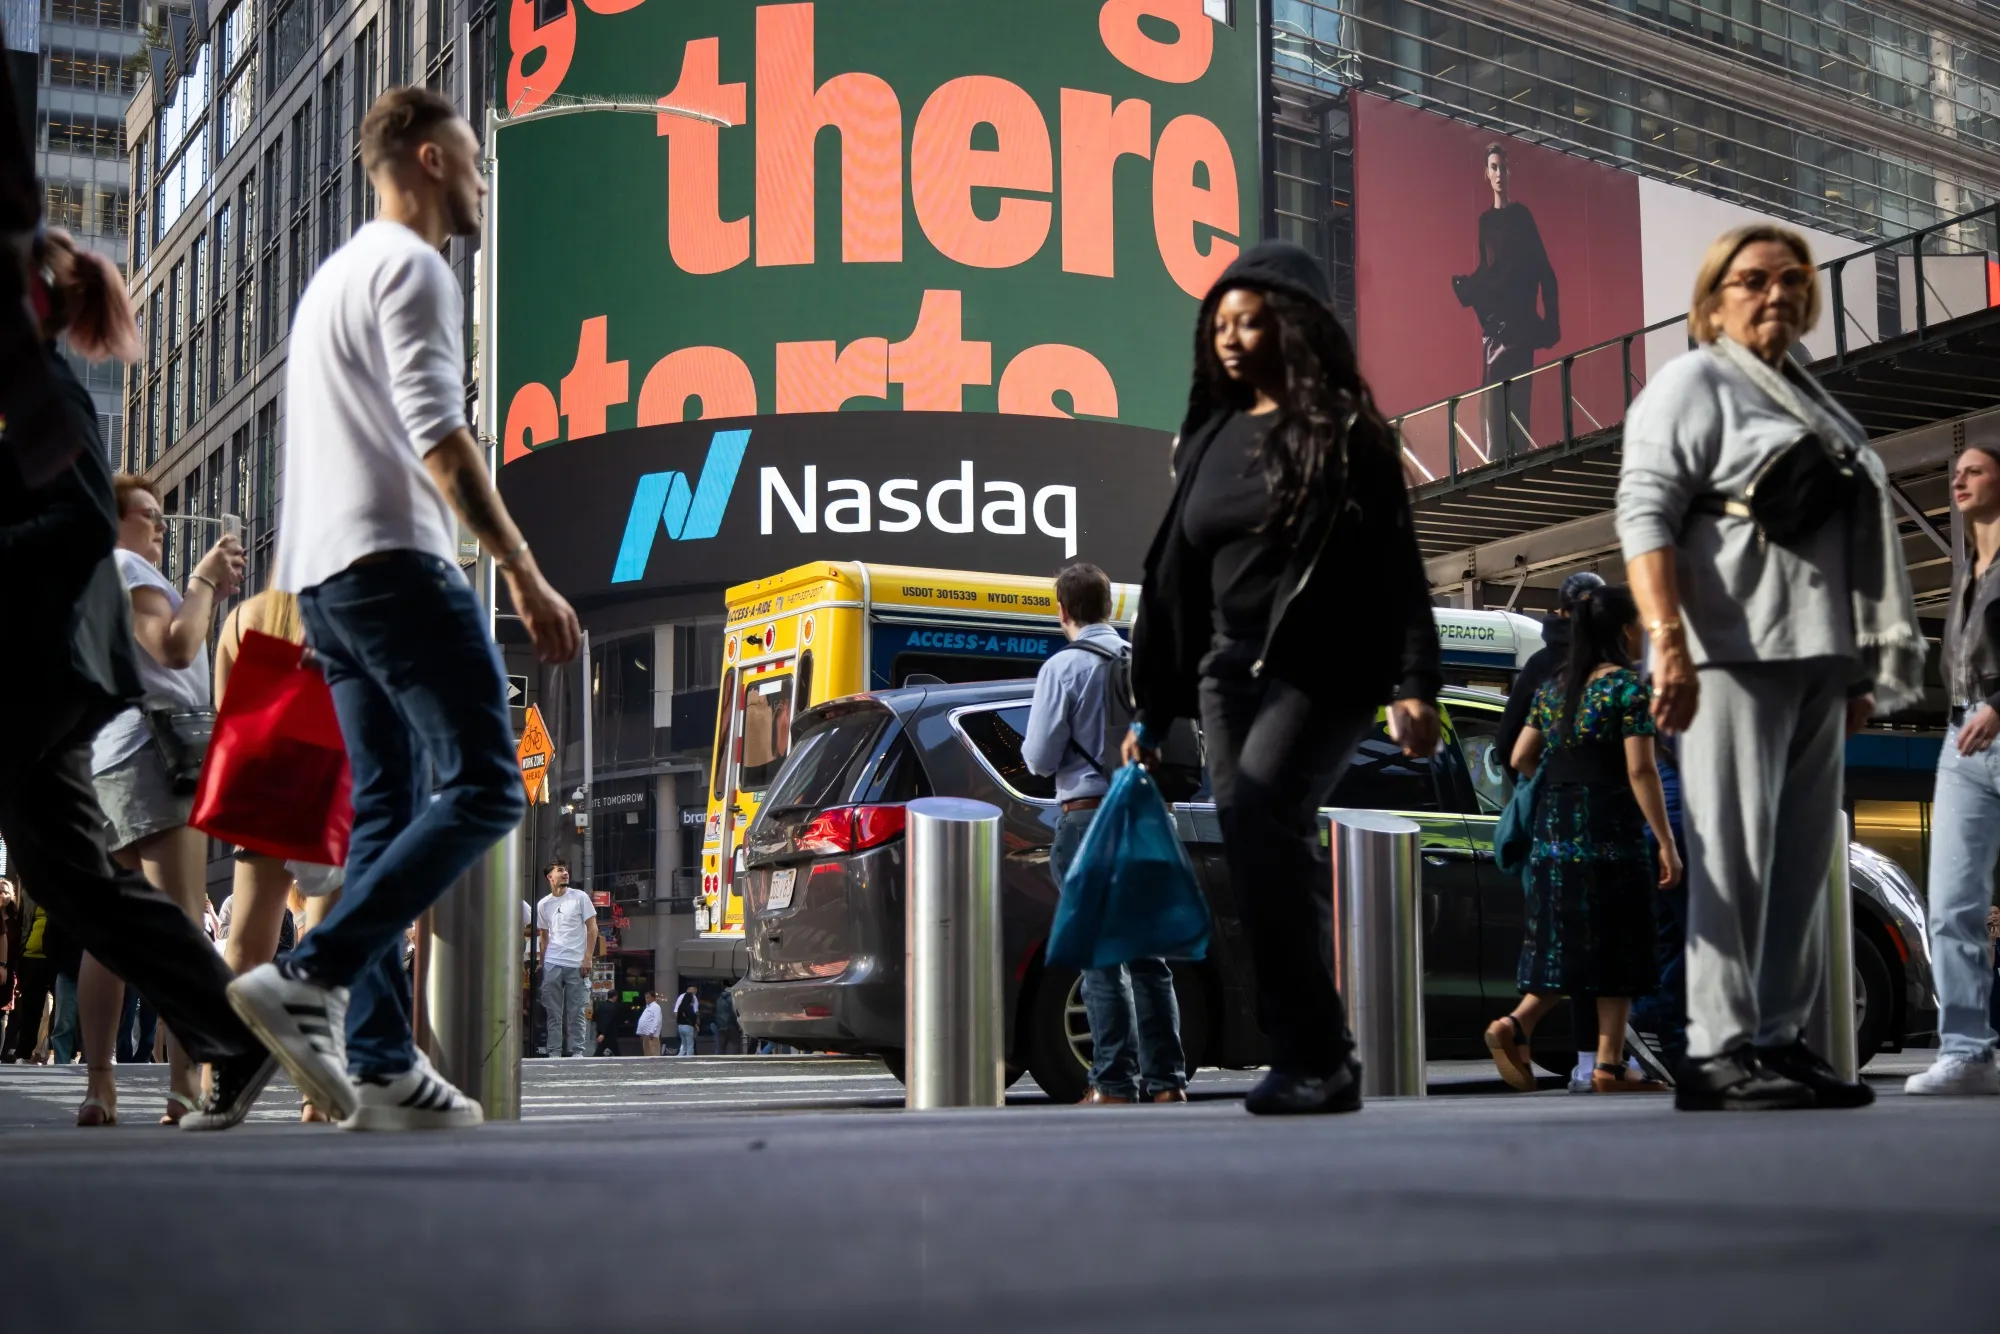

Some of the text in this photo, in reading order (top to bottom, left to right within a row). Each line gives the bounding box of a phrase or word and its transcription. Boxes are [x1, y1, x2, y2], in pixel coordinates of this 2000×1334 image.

[656, 3, 1240, 300] there
[760, 461, 1077, 559] Nasdaq
[902, 586, 977, 601] USDOT 3015339
[988, 593, 1050, 607] NYDOT 35388
[727, 600, 772, 622] ACCESS-A-RIDE
[906, 631, 1049, 654] ACCESS-A-RIDE
[523, 754, 544, 769] WORK ZONE
[526, 771, 540, 780] AHEAD
[603, 793, 644, 806] TOMORROW
